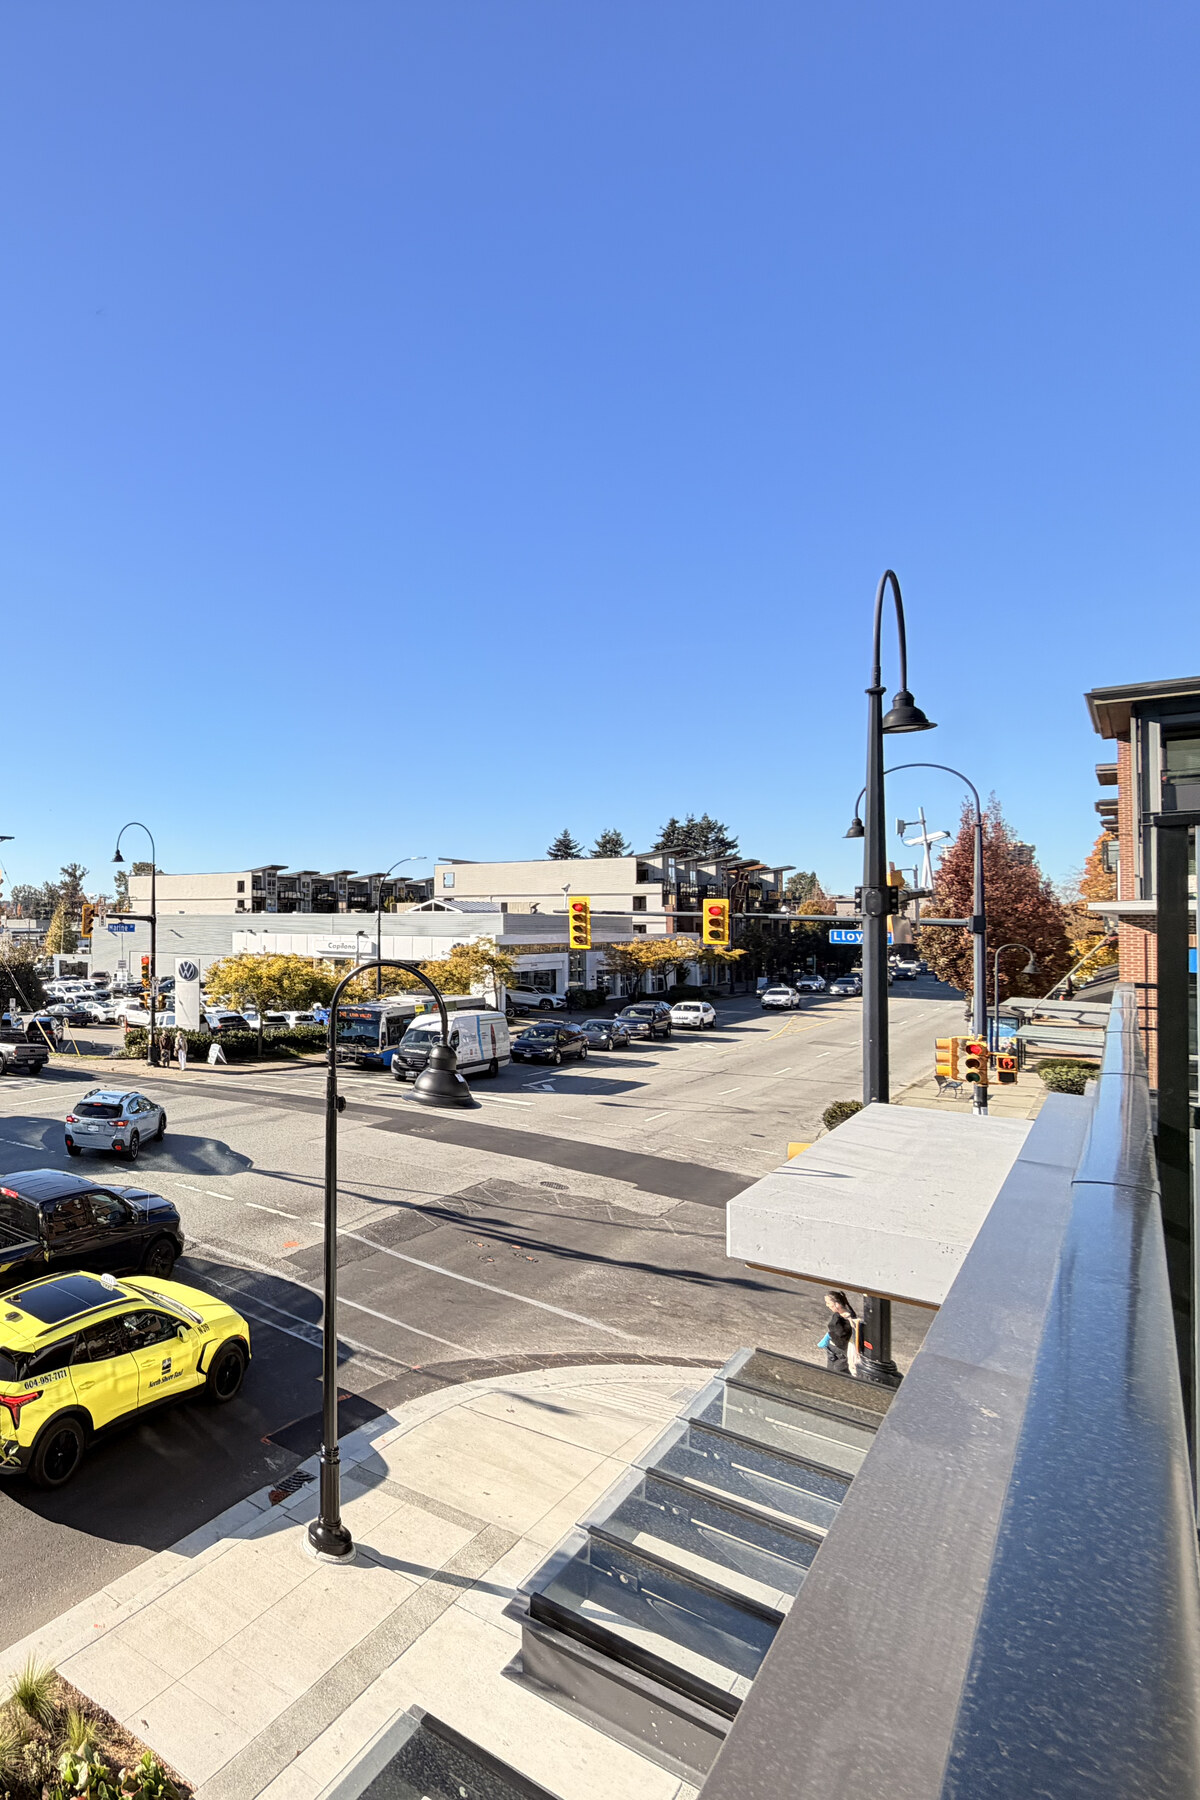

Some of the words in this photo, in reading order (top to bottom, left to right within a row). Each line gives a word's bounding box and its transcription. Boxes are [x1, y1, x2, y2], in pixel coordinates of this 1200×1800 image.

[109, 924, 129, 932] Marine
[833, 931, 863, 943] Lloy
[327, 942, 357, 951] Capilano
[24, 1369, 68, 1390] 604-987-7171
[148, 1377, 161, 1388] North
[160, 1373, 174, 1384] Shore
[173, 1368, 184, 1379] Taxi
